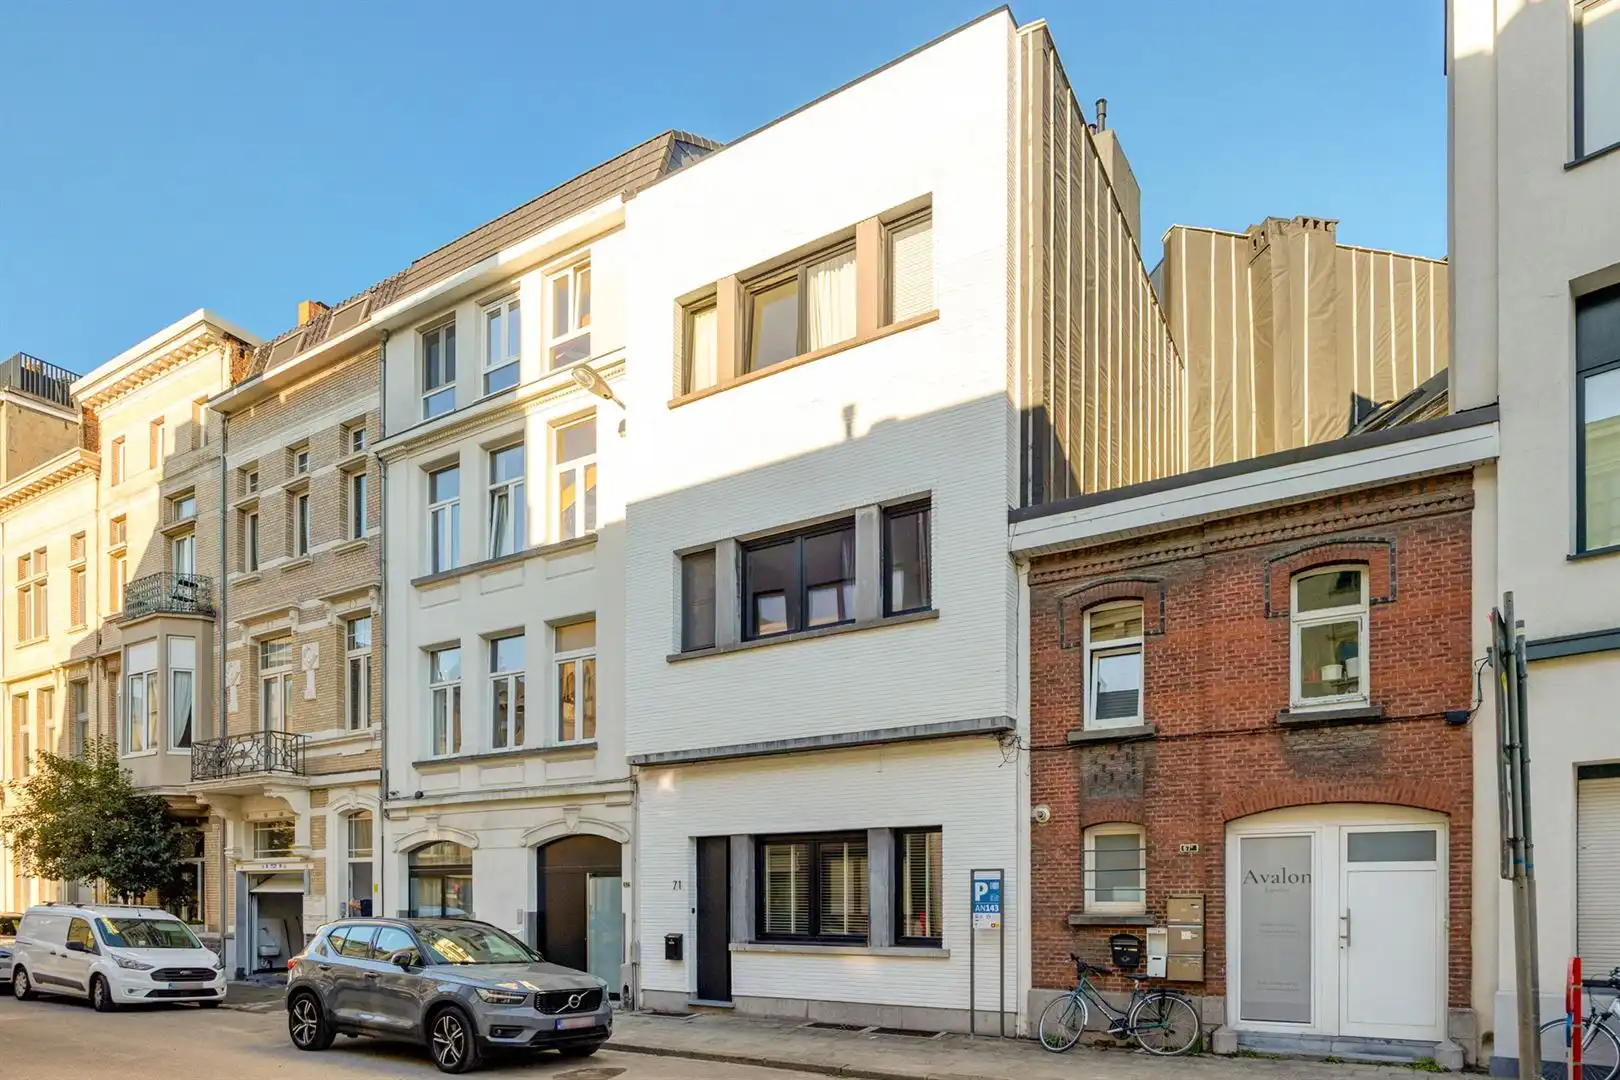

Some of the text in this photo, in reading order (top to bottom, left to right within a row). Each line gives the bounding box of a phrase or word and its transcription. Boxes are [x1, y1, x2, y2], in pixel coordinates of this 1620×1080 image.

[1243, 867, 1312, 884] Avalon
[672, 880, 682, 890] 71
[974, 881, 989, 902] P
[975, 904, 1000, 912] AN143
